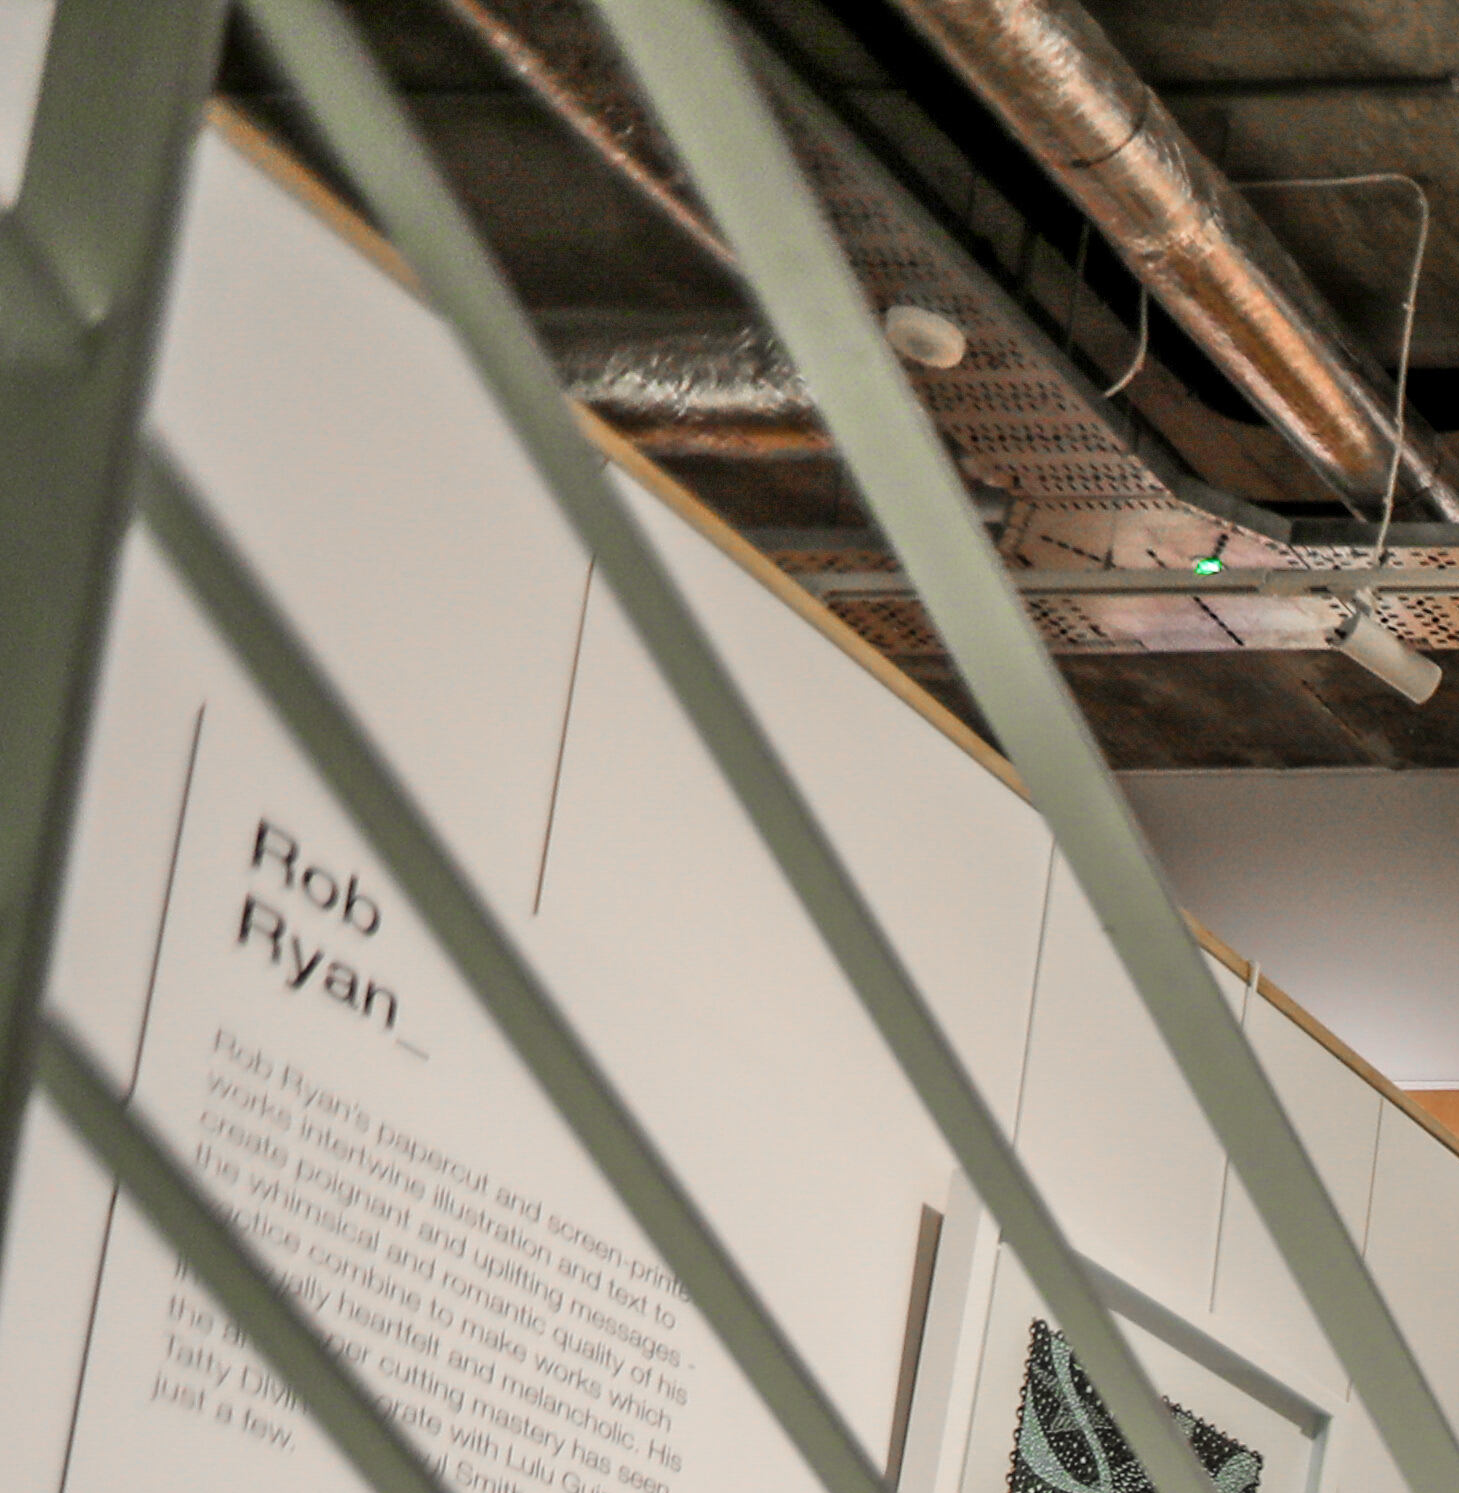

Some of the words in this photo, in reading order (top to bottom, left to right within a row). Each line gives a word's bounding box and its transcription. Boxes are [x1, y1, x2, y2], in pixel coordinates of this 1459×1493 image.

[249, 817, 384, 939] Rob
[192, 1143, 240, 1187] the
[247, 1175, 381, 1256] whimsical
[385, 1244, 437, 1284] and
[440, 1271, 547, 1338] romantic
[550, 1327, 624, 1381] quality
[628, 1365, 654, 1390] of
[655, 1374, 689, 1408] his
[198, 1110, 289, 1171] create
[294, 1159, 412, 1233] poignant
[417, 1221, 469, 1261] and
[472, 1249, 565, 1314] uplifting
[569, 1298, 683, 1368] messages
[206, 1073, 293, 1135] works
[298, 1115, 427, 1204] intertwine
[431, 1185, 553, 1268] illustration
[556, 1256, 603, 1294] and
[605, 1277, 650, 1318] text
[651, 1301, 677, 1332] to
[210, 1026, 275, 1084] Rob
[280, 1063, 371, 1135] Ryan's
[374, 1121, 491, 1197] papercut
[494, 1184, 544, 1225] and
[545, 1212, 693, 1304] screen-printe
